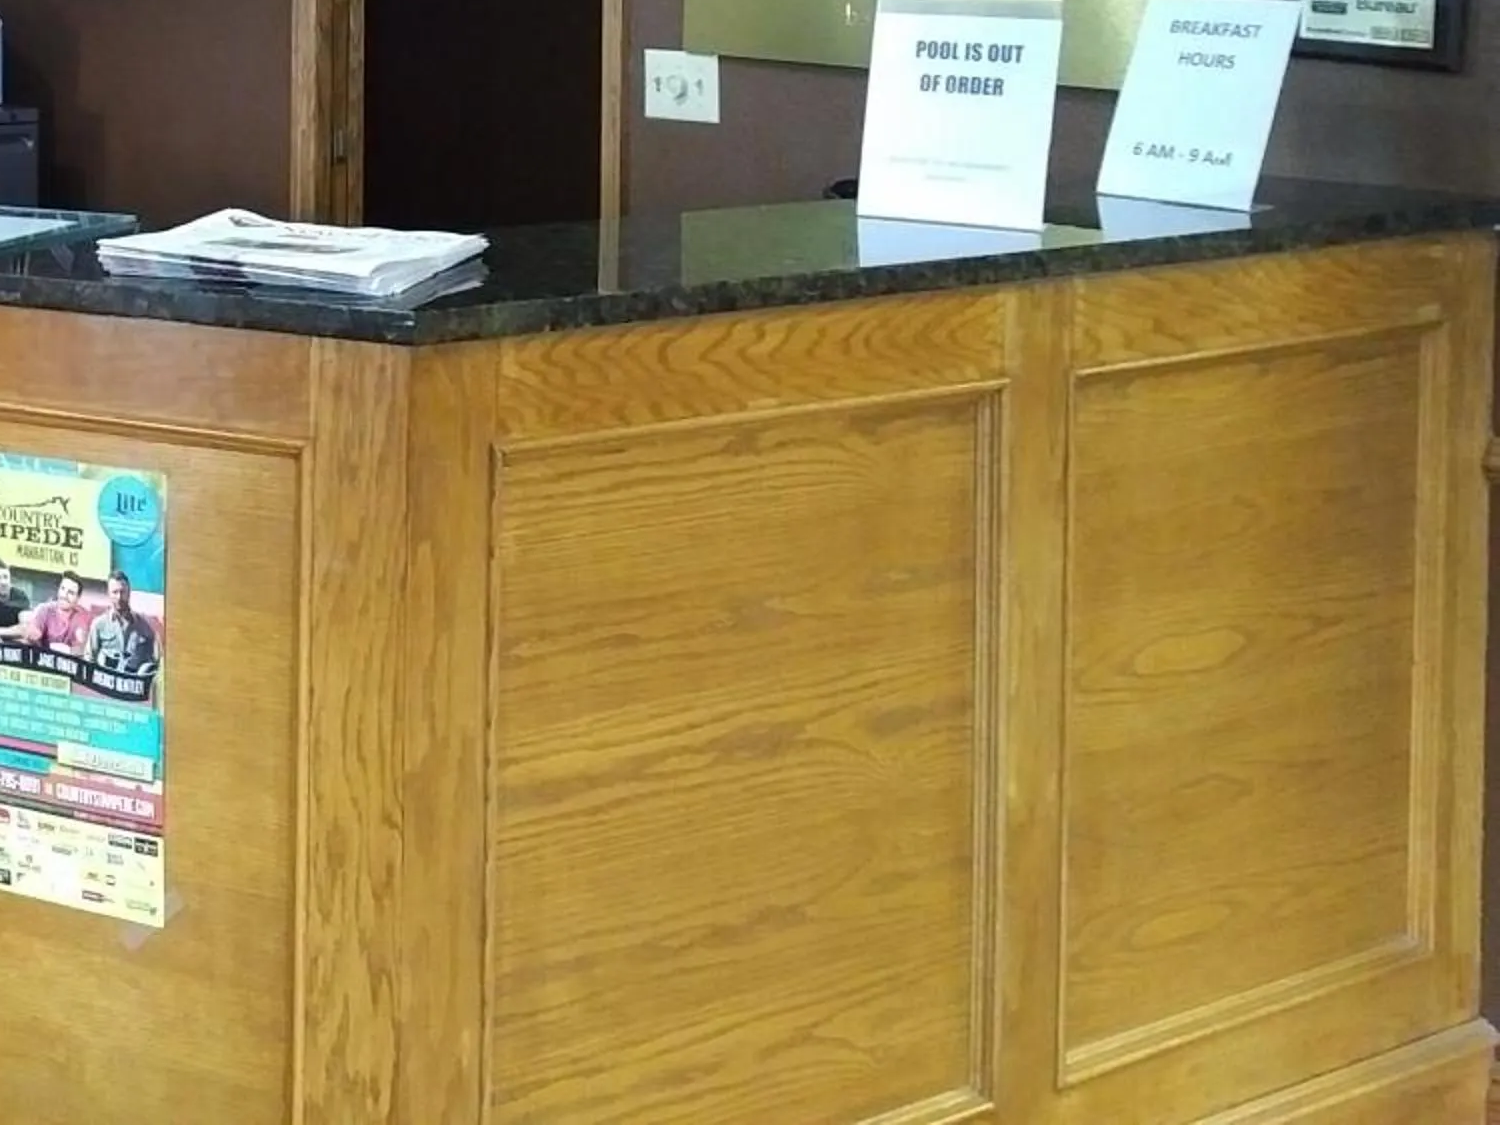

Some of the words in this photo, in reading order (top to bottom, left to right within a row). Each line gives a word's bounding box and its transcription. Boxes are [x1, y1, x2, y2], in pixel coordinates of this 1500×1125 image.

[1169, 19, 1263, 38] BREAKFAST
[915, 39, 960, 61] POOL
[964, 41, 983, 62] IS
[987, 43, 1025, 64] OUT
[1177, 51, 1237, 70] HOURS
[919, 73, 942, 93] OF
[945, 74, 1004, 96] ORDER
[1133, 141, 1144, 157] 6
[1145, 143, 1175, 161] AM
[1188, 148, 1200, 164] 9
[115, 491, 147, 516] Lite
